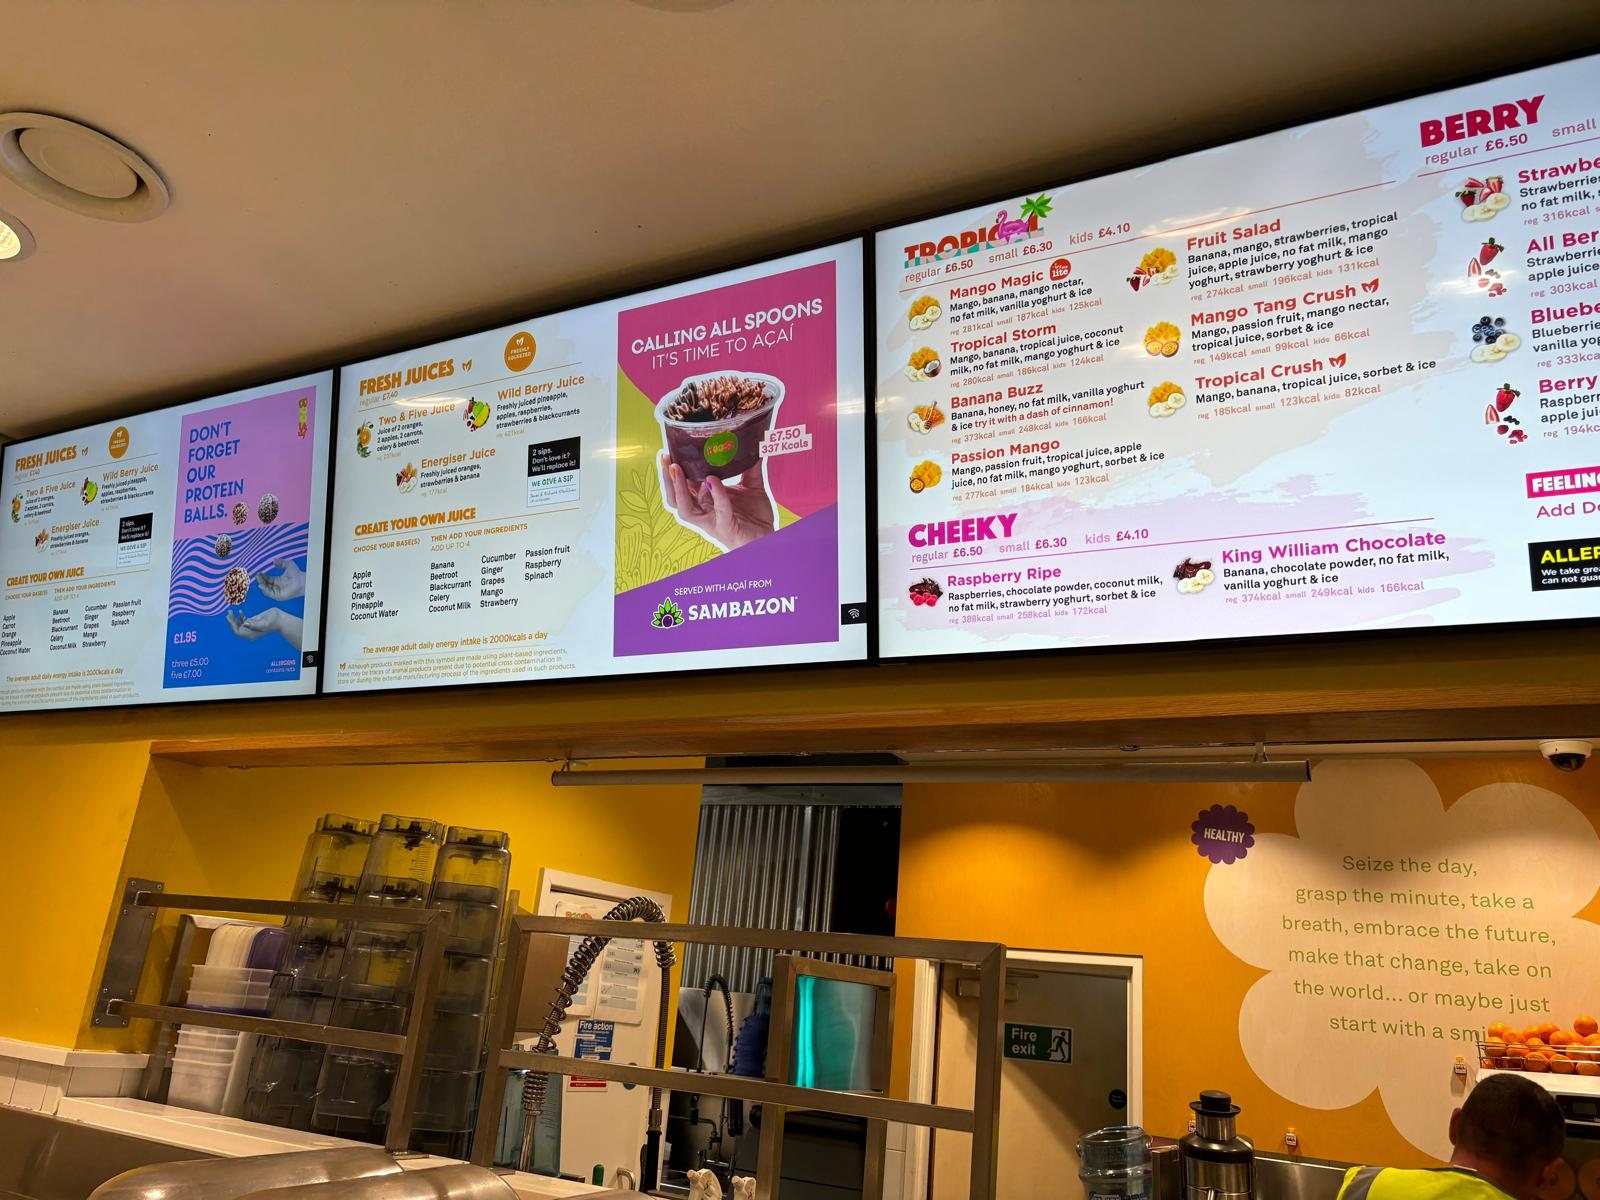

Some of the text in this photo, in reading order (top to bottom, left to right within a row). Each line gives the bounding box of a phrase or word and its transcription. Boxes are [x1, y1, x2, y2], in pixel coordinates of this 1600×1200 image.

[1420, 95, 1545, 148] BERRY
[1425, 118, 1596, 165] regular £6.50 small
[1522, 190, 1595, 211] no fat milk,
[1187, 220, 1280, 250] Fruit Salad
[905, 222, 1130, 282] regular £6.50 small £6.30 kids £4.10
[950, 272, 1043, 299] Mango Magic
[1191, 285, 1356, 325] Mango Tang Crush
[631, 300, 822, 354] CALLING ALL SPOONS
[1191, 300, 1389, 339] Mango, passion fruit, mango nectar,
[652, 324, 792, 369] IT'S TIME TO AÇAÍ
[950, 326, 1056, 353] Tropical Storm
[1191, 321, 1333, 351] tropical juice, sorbet & ice
[360, 359, 454, 396] FRESH JUICES
[1194, 359, 1323, 390] Tropical Crush
[1539, 375, 1598, 393] Berry
[497, 376, 584, 400] Wild Berry Juice
[951, 386, 1043, 408] Banana Buzz
[378, 403, 458, 425] Two & Five Juice
[190, 422, 231, 443] DON'T
[770, 428, 800, 442] £7.50
[16, 445, 77, 471] FRESH JUICES
[188, 440, 240, 463] FORGET
[762, 440, 808, 454] 337 Kcals
[951, 441, 1059, 464] Passion Mango
[421, 449, 495, 469] Energiser Juice
[187, 465, 215, 483] OUR
[186, 479, 244, 503] PROTEIN
[184, 504, 227, 523] BALLS.
[354, 507, 476, 536] CREATE YOUR OWN JUICE
[1537, 503, 1575, 518] Add
[909, 513, 1018, 547] CHEEKY
[526, 545, 570, 558] Passion fruit
[912, 528, 1148, 564] regular £6.50 small £6.30 kids £4.10
[1222, 533, 1445, 564] King William Chocolate
[431, 561, 454, 569] Banana
[482, 553, 516, 563] Cucumber
[525, 559, 561, 570] Raspberry
[1223, 551, 1449, 578] Banana, chocolate powder, no fat milk,
[6, 567, 84, 586] CREATE YOUR OWN JUICE
[353, 570, 371, 580] Apple
[481, 566, 503, 575] Ginger
[525, 571, 553, 581] Spinach
[947, 568, 1061, 587] Raspberry Ripe
[352, 581, 372, 590] Carrot
[352, 591, 374, 600] Orange
[430, 580, 471, 591] Blackcurrant
[674, 585, 703, 596] SERVED
[704, 582, 725, 593] WITH
[748, 578, 771, 589] FROM
[948, 575, 1162, 602] Raspberries, chocolate powder, coconut milk,
[351, 600, 383, 610] Pineapple
[480, 598, 518, 608] Strawberry
[688, 597, 795, 620] SAMBAZON
[174, 631, 196, 643] £1.95
[1204, 827, 1245, 844] HEALTHY
[1342, 855, 1477, 877] Seize the day,
[1296, 888, 1534, 909] grasp the minute, take a
[1282, 915, 1555, 946] breath, embrace the future,
[1288, 948, 1551, 978] make that change, take on
[1293, 978, 1324, 996] the
[1408, 990, 1428, 1003] or
[1435, 991, 1502, 1011] maybe
[1509, 996, 1550, 1014] just
[579, 1021, 613, 1031] Fire action
[1011, 1028, 1037, 1041] Fire
[1329, 1015, 1488, 1042] start with a smi
[1012, 1044, 1036, 1055] exit
